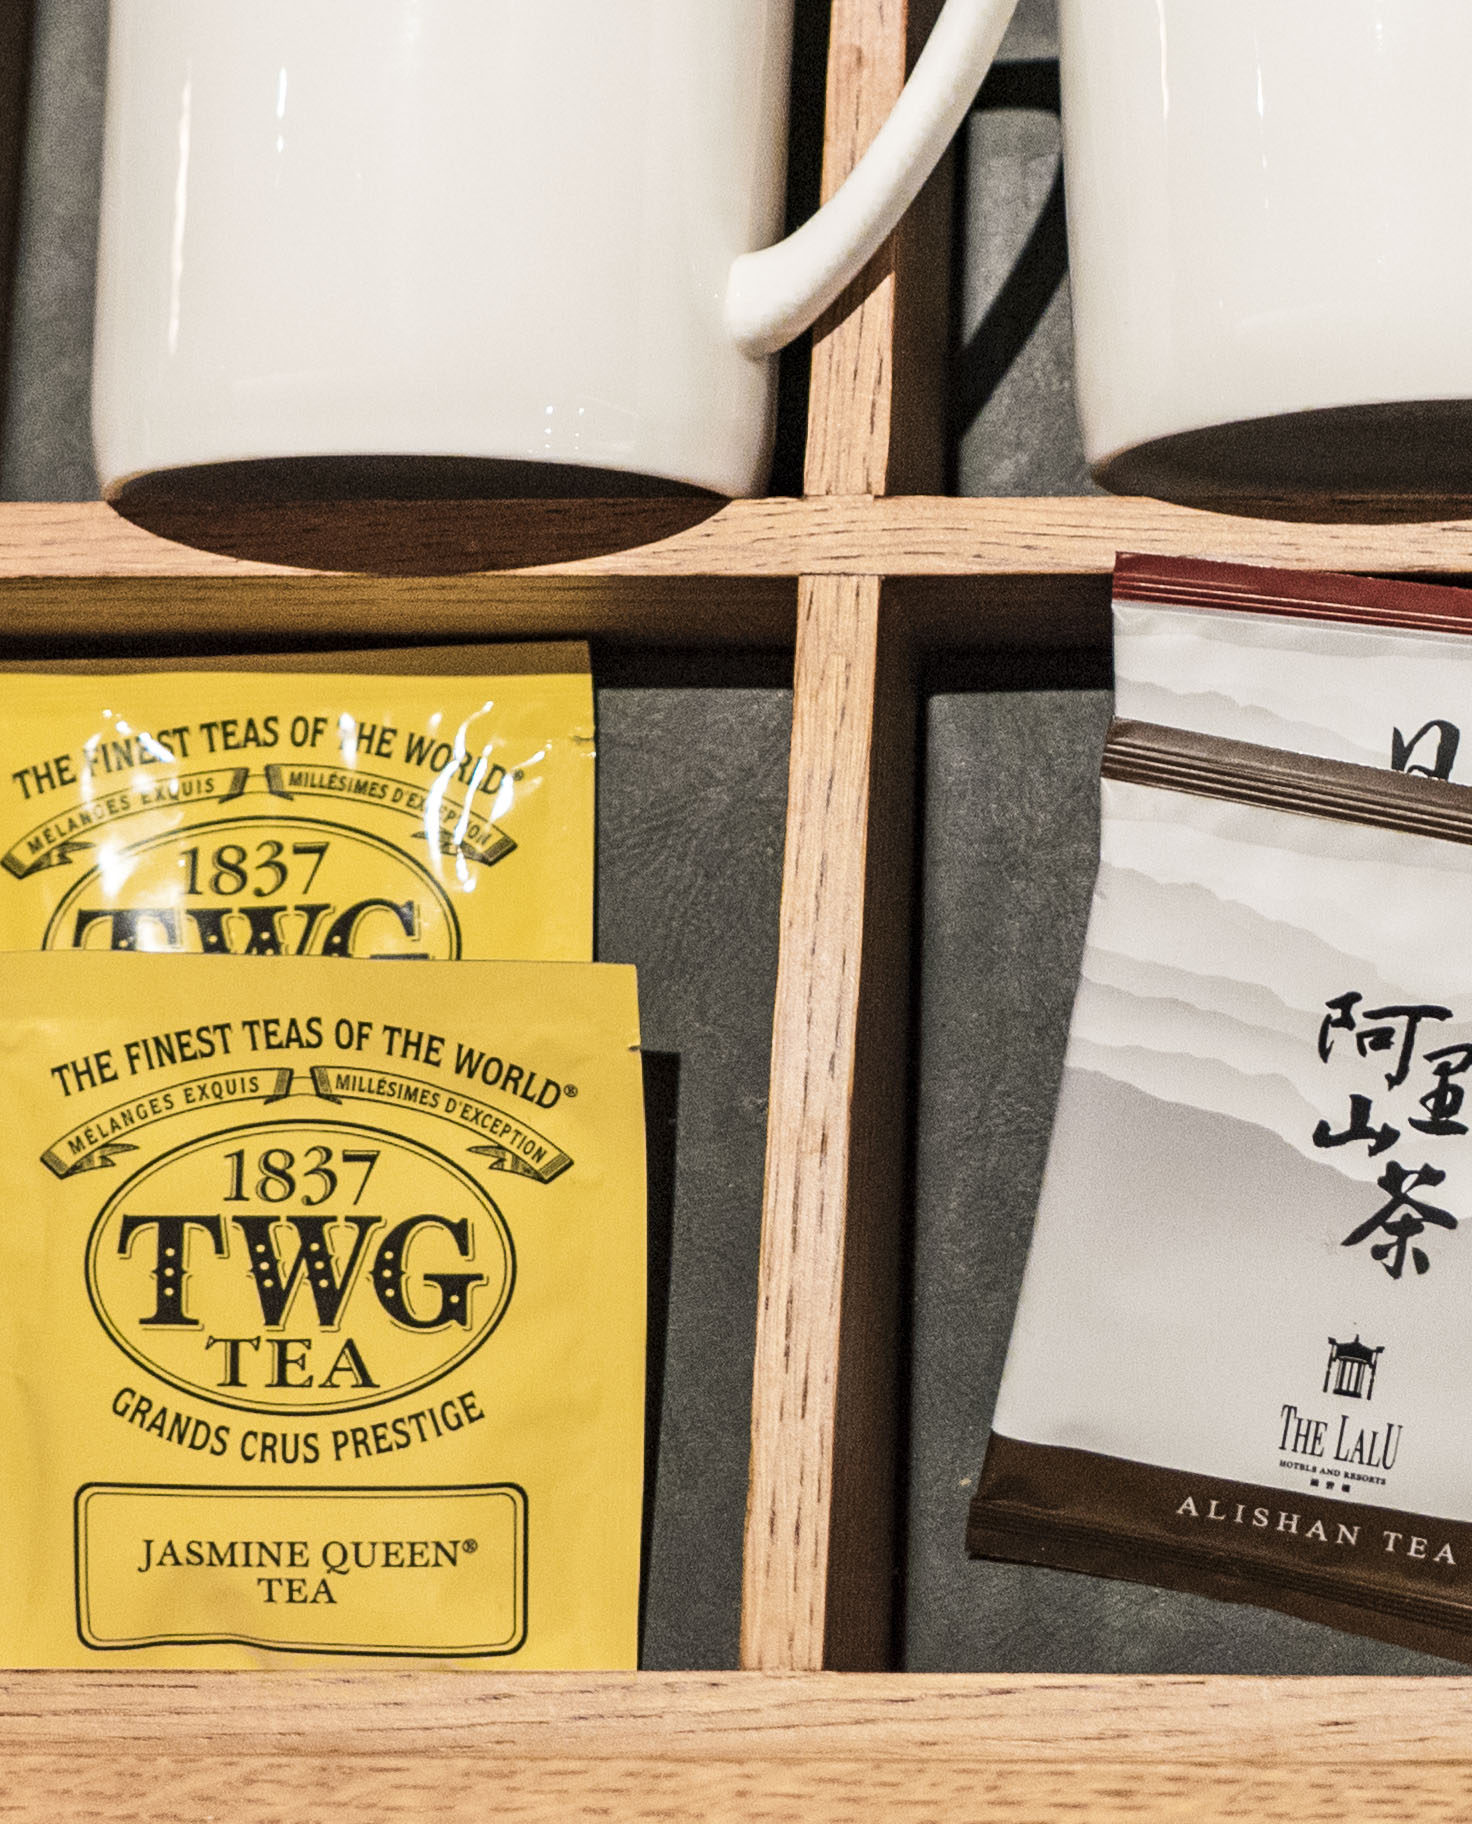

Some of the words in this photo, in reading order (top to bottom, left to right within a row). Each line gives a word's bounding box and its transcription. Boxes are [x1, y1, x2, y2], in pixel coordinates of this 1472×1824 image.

[12, 755, 77, 799] THE
[200, 716, 278, 753] TEAS
[290, 716, 328, 748] OF
[339, 717, 397, 758] HE
[179, 840, 329, 897] 1837
[50, 1051, 120, 1098] THE
[127, 1023, 233, 1076] FINEST
[246, 1017, 324, 1050] TEAS
[335, 1018, 372, 1051] OF
[382, 1025, 447, 1067] THE
[184, 1073, 262, 1105] EXQUIS
[334, 1072, 441, 1109] MILLÉSIMES
[443, 1094, 548, 1165] D'EXCEPTION
[222, 1145, 381, 1207] 1837
[116, 1213, 489, 1332] TWG
[205, 1334, 381, 1391] TEA
[110, 1387, 230, 1456] GRANDS
[240, 1430, 319, 1464] CRUS
[333, 1389, 485, 1463] PRESTIGE
[1279, 1404, 1328, 1457] THE
[1280, 1460, 1317, 1473] HOTELS
[1320, 1468, 1341, 1477] AND
[1344, 1471, 1386, 1485] RESORTS
[137, 1539, 310, 1574] JASMINE
[1175, 1495, 1360, 1547] ALISHAN
[1382, 1530, 1459, 1566] TEA
[257, 1578, 337, 1606] TEA
